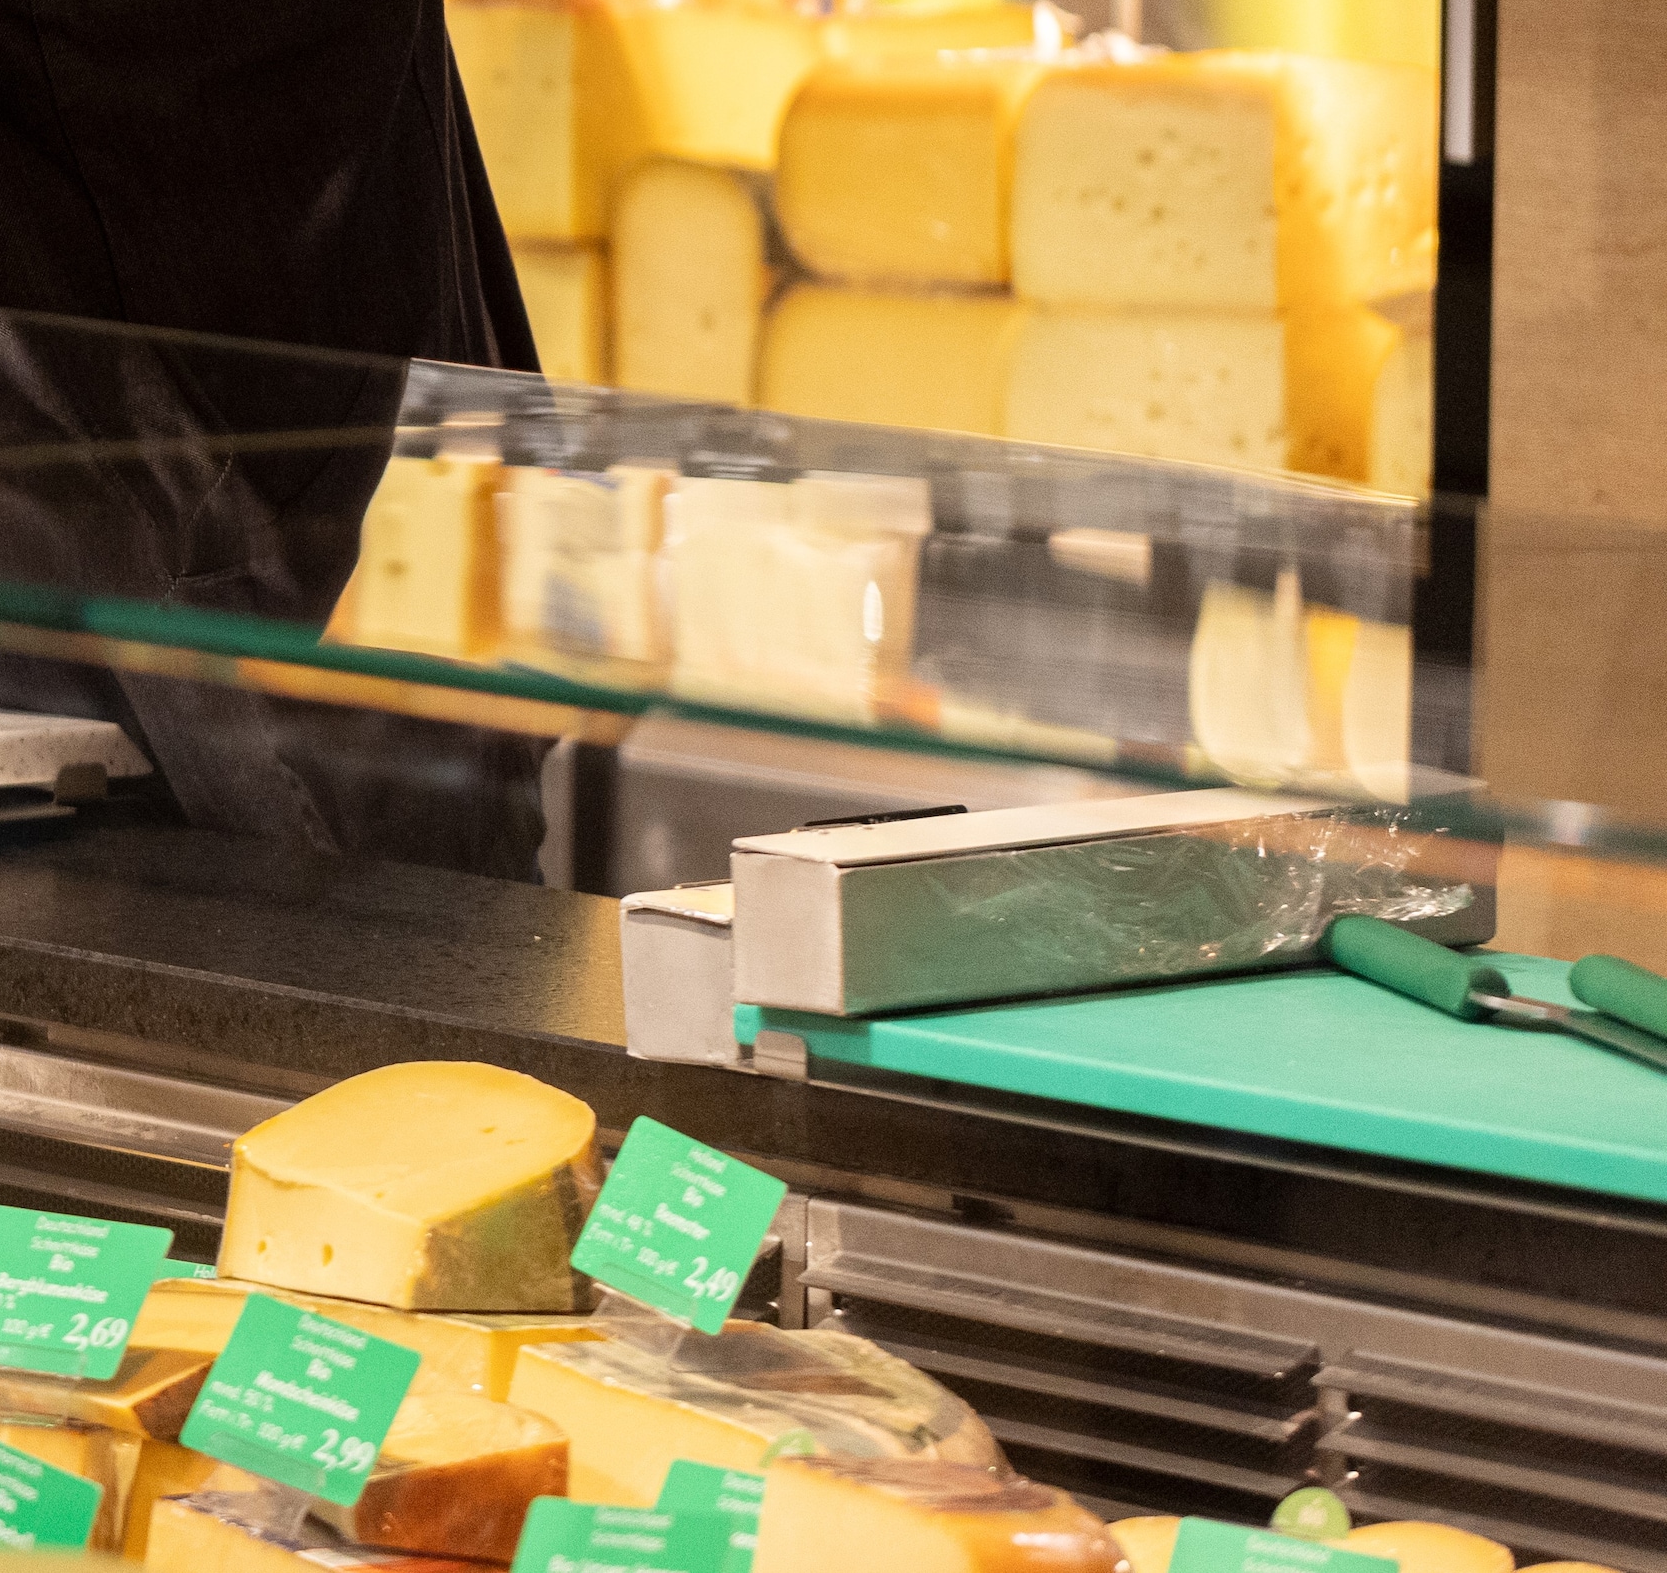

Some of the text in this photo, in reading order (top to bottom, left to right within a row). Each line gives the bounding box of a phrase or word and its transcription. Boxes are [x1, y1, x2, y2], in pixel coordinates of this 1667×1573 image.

[48, 1253, 75, 1273] Bio
[683, 1256, 739, 1302] 2,49
[62, 1312, 129, 1352] 2,69
[311, 1428, 376, 1474] 2,99
